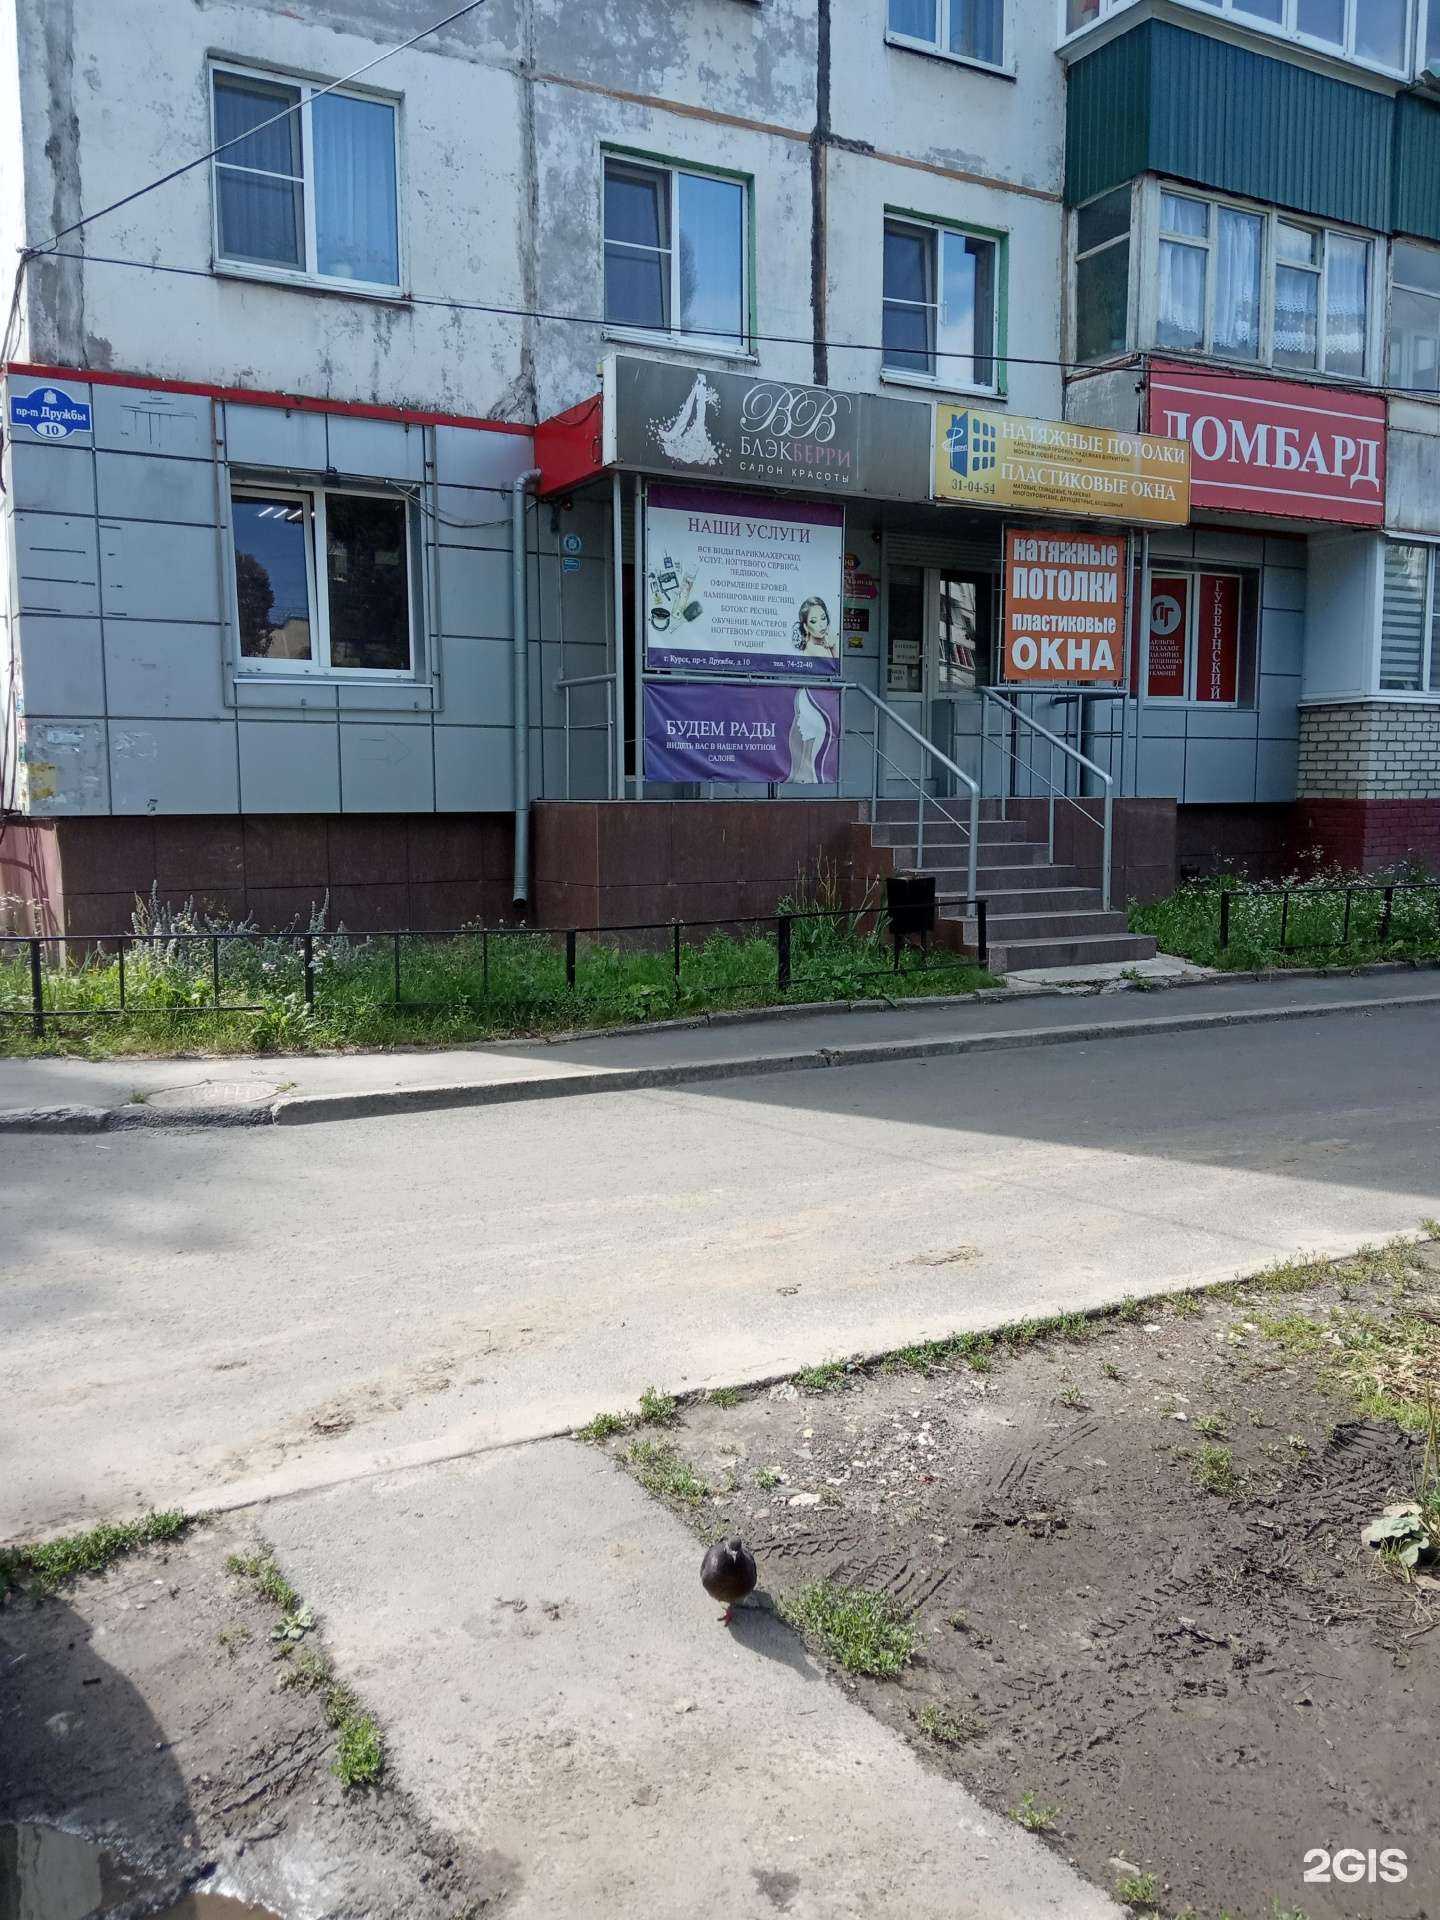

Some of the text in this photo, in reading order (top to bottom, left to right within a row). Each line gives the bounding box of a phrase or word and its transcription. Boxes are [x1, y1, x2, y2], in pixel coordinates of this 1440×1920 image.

[16, 406, 86, 421] пр-т Дружбы
[45, 424, 59, 435] 10
[1001, 421, 1103, 453] НАТЯЖНЫЕ
[1107, 438, 1185, 464] ПОТОЛКИ
[741, 436, 852, 468] БЛЭКБЕРРИ
[740, 461, 849, 483] САЛОН КРАСОТЫ
[951, 479, 995, 494] 31-04-54
[1000, 463, 1176, 501] ПЛАСТИКОВЫЕ ОКНА
[688, 517, 811, 543] НАШИ УСЛУГИ
[697, 545, 801, 561] ВСЕ ВИДЫ ПАРИКМАХЕРСКИХ
[1013, 538, 1118, 567] натяжные
[725, 558, 766, 568] НОГТЕВОГО
[729, 569, 768, 578] ПЕДИКЮРА
[710, 580, 788, 592] ОФОРМЛЕНИЕ БРОВЕЙ
[1012, 567, 1117, 604] ПОТОЛКИ
[703, 591, 795, 604] ЛАМИНИРОВАНИЕ РЕСНИЦ
[721, 605, 778, 616] БОТОКС РЕСНИЦ
[711, 617, 787, 628] ОБУЧЕНИЕ МАСТЕРОВ
[1012, 614, 1117, 634] пластиковые
[711, 627, 787, 638] НОГТЕВОМУ СЕРВИСУ
[1211, 580, 1223, 699] ГУБЕРНСКИЙ
[670, 654, 691, 665] Курск,
[708, 657, 736, 666] Дружбы,
[1011, 636, 1115, 671] ОКНА
[666, 720, 776, 740] БУДЕМ РАДЫ
[666, 742, 694, 750] ВИДЕТЬ
[717, 743, 743, 751] НАШЕМ
[745, 743, 776, 751] УЮТНОМ
[708, 754, 735, 762] САЛОНЕ
